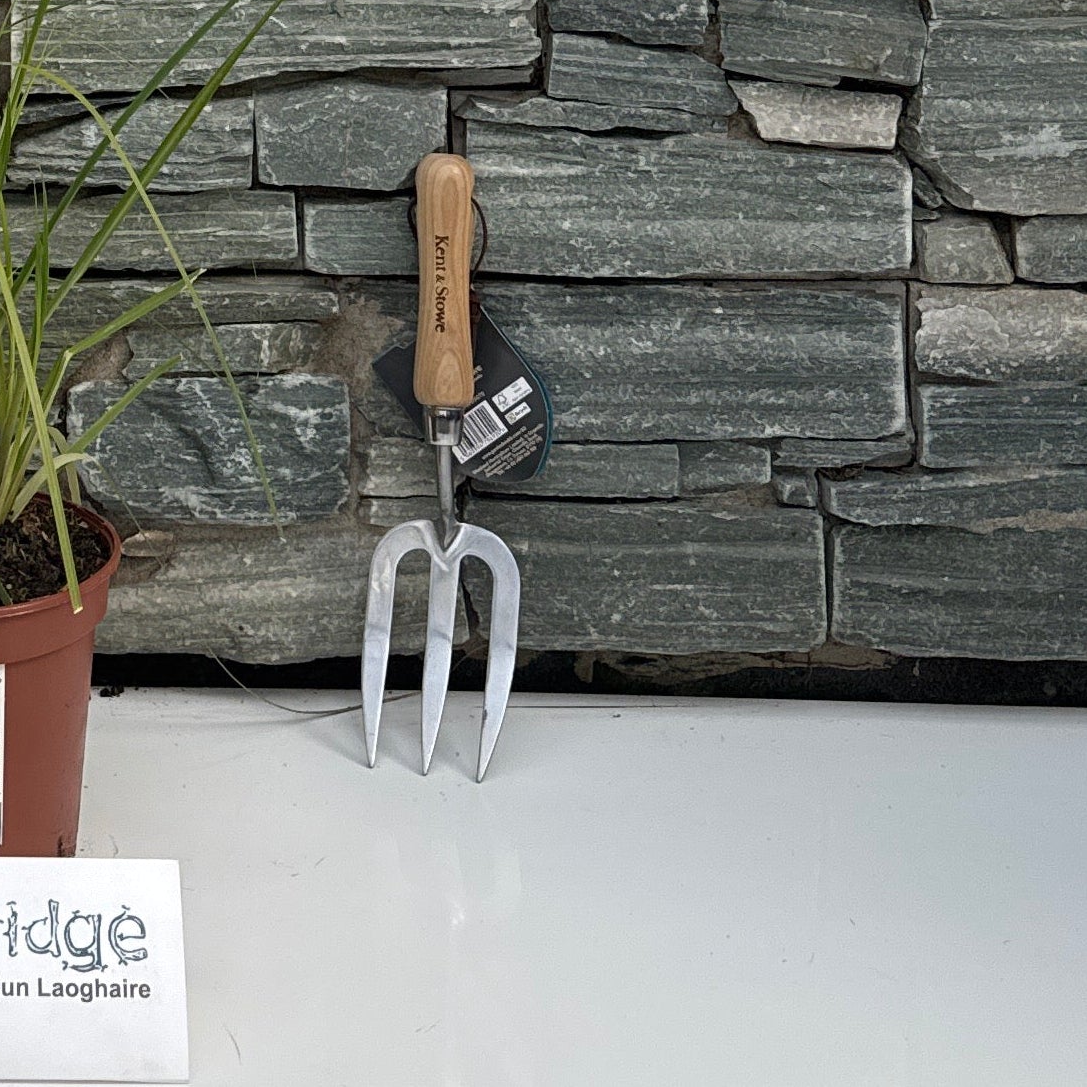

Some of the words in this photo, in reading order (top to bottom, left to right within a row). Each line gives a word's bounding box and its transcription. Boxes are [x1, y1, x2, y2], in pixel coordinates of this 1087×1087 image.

[435, 234, 450, 272] Kent
[435, 274, 445, 284] &
[435, 286, 450, 333] Stowe
[37, 978, 152, 1003] Laoghaire
